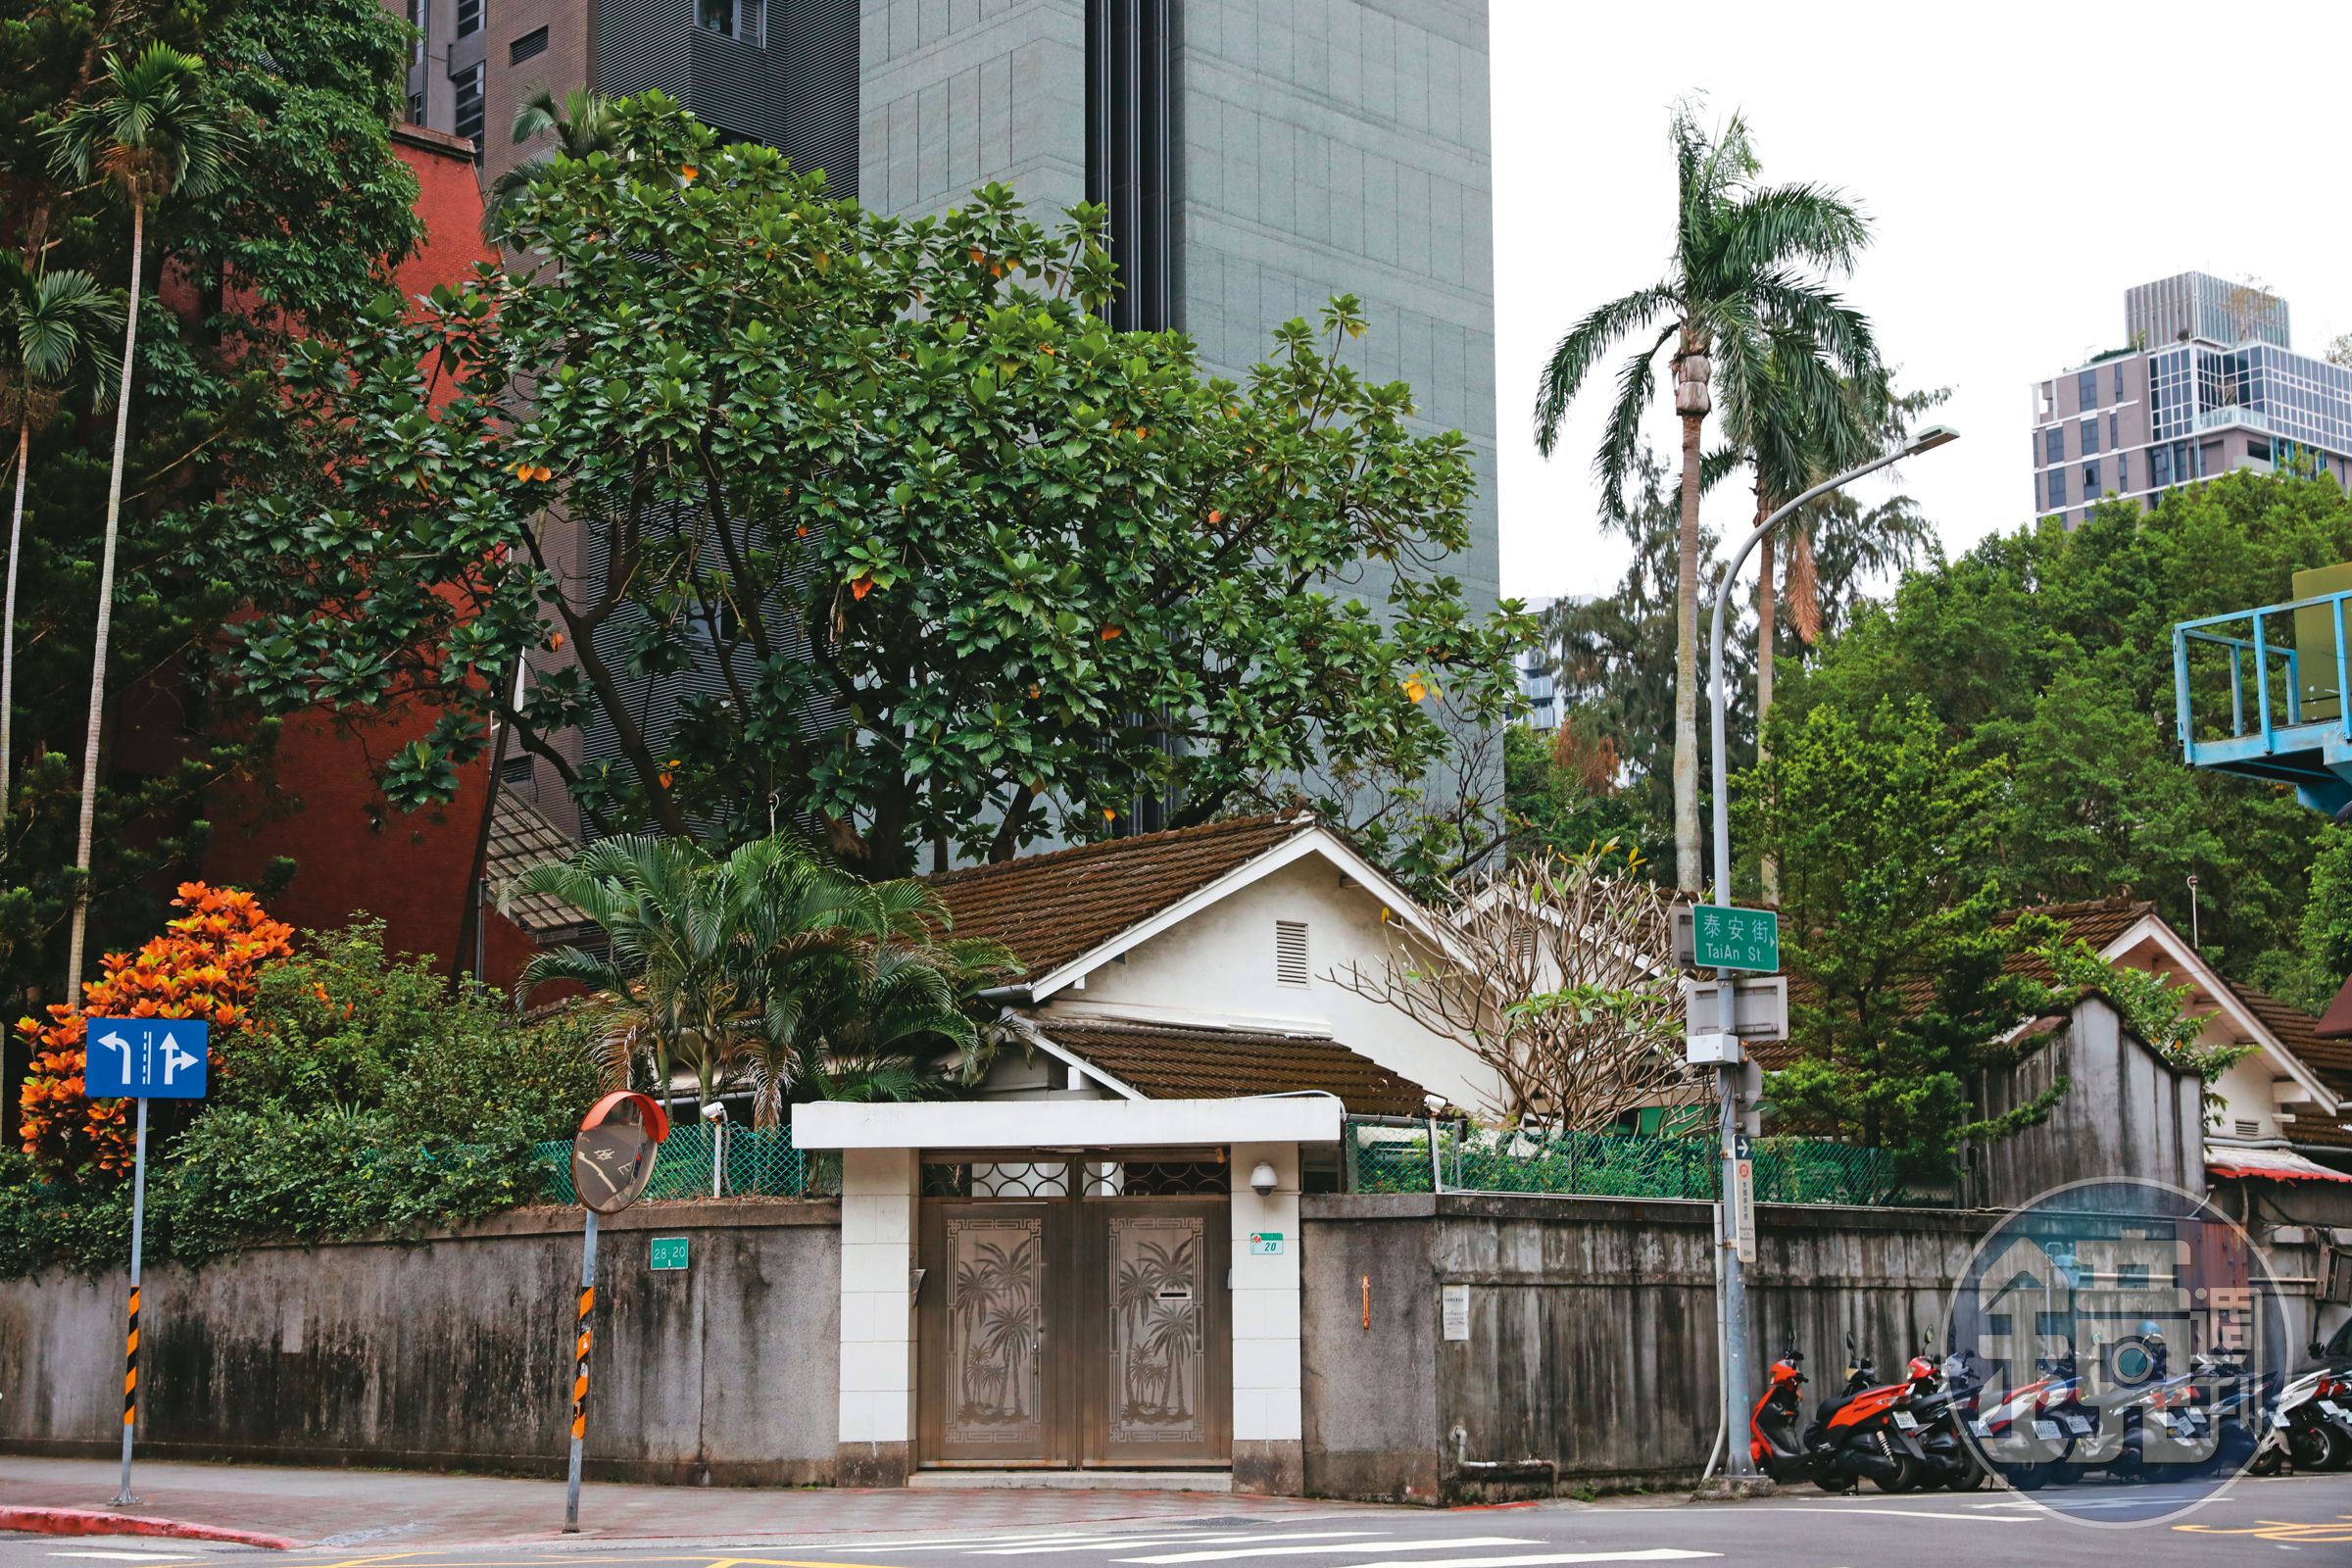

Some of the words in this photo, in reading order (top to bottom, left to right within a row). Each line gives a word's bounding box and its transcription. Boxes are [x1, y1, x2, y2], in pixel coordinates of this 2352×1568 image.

[1703, 913, 1769, 944] 泰安街
[1705, 942, 1740, 961] TaiAn
[1747, 946, 1764, 963] St.
[654, 1248, 667, 1260] 28
[672, 1246, 686, 1258] 20
[1264, 1242, 1277, 1251] 20
